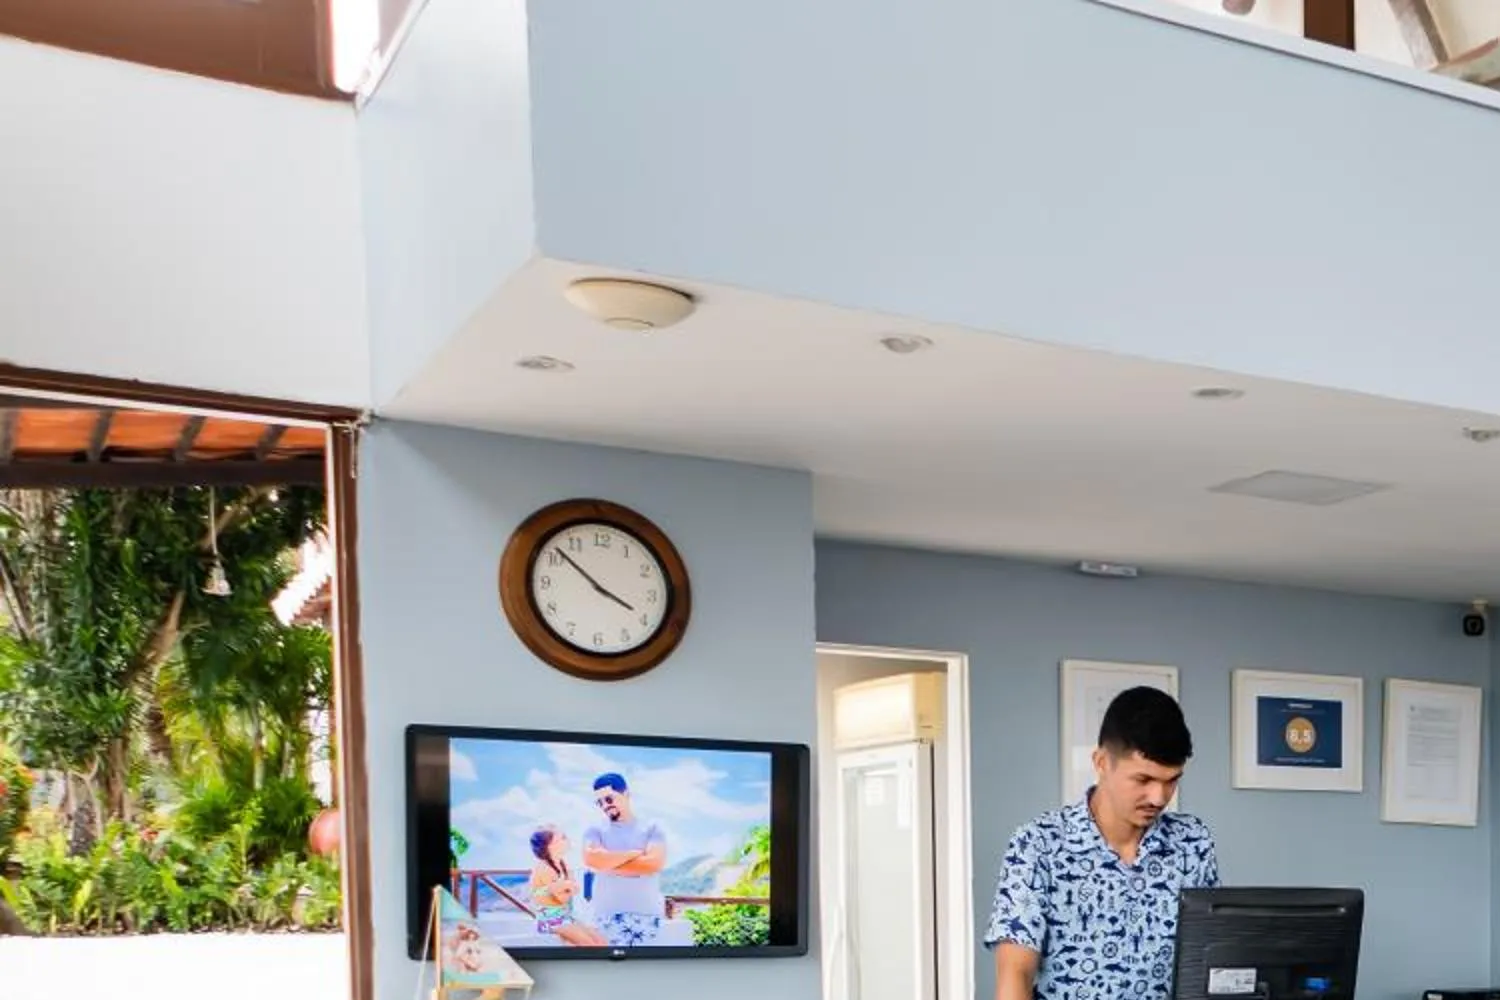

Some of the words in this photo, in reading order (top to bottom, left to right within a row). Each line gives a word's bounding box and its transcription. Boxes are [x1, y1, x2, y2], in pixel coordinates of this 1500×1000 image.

[569, 537, 582, 552] 11
[592, 532, 611, 548] 12
[623, 545, 630, 558] 1
[640, 564, 651, 578] 2
[541, 576, 551, 589] 9
[647, 589, 657, 604] 3
[639, 613, 648, 626] 4
[593, 632, 604, 646] 6
